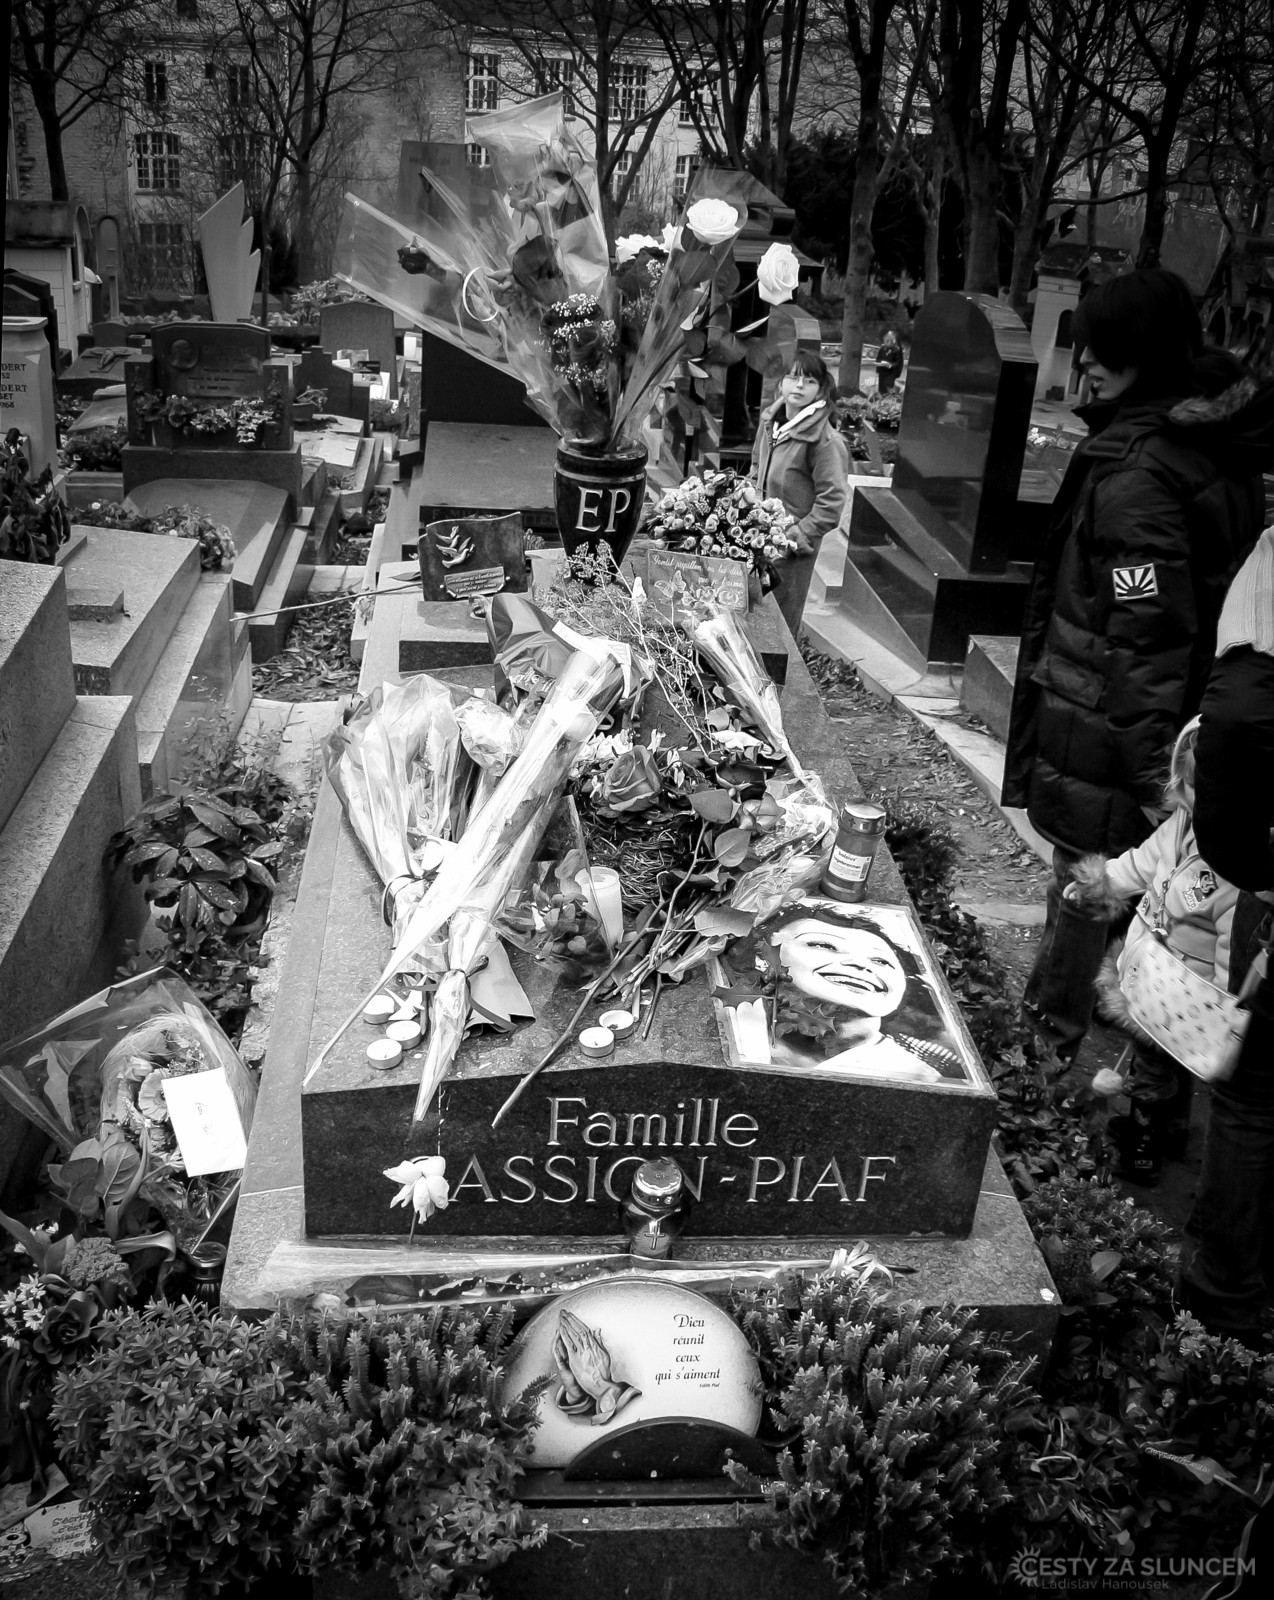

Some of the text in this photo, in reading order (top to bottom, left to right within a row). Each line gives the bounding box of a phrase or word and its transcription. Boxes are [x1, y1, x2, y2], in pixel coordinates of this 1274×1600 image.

[574, 485, 632, 533] EP
[545, 1096, 760, 1147] Famille
[448, 1154, 898, 1204] ASSION-PIAF
[673, 1313, 705, 1328] Dieu
[673, 1334, 705, 1346] réunit
[675, 1353, 701, 1362] ceux
[655, 1366, 720, 1385] qui s'aiment
